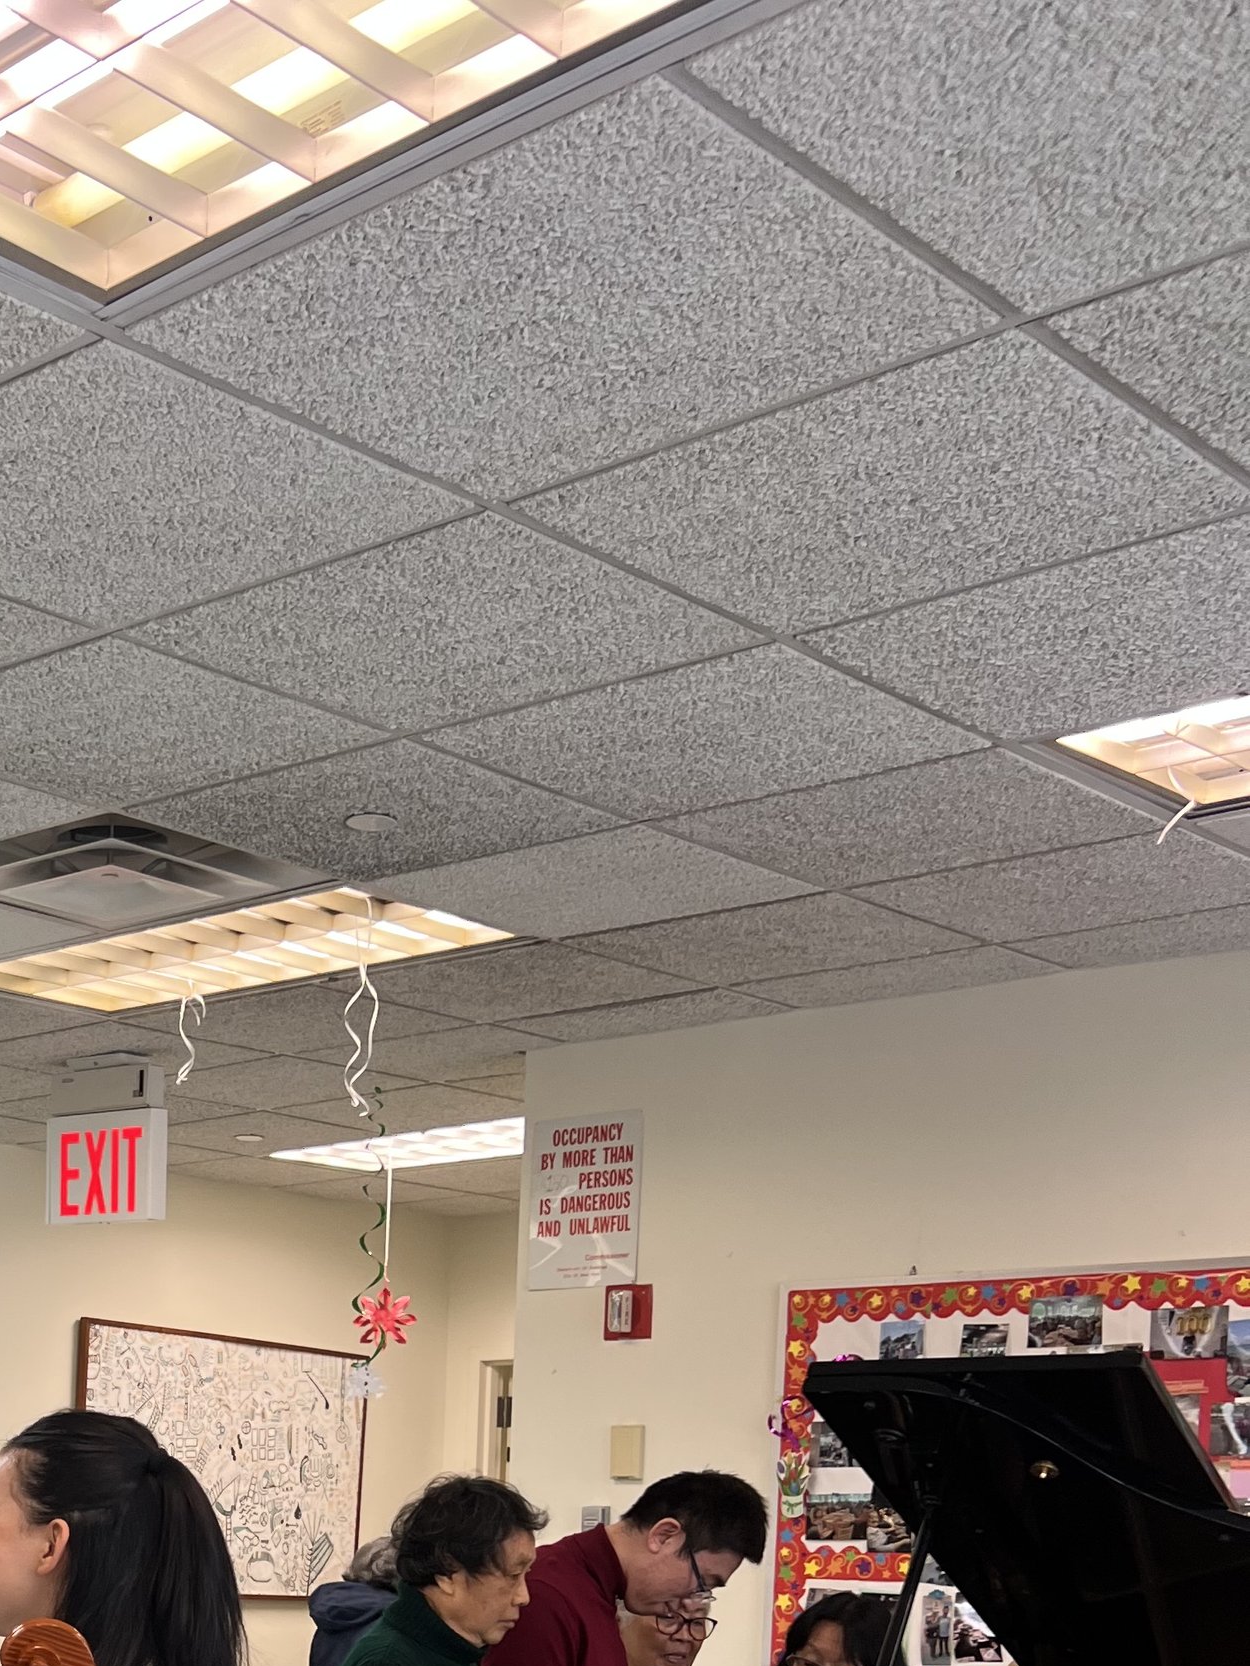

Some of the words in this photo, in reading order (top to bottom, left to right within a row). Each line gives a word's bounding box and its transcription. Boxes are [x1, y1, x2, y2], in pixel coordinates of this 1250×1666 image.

[552, 1122, 624, 1147] OCCUPANCY
[541, 1152, 556, 1171] BY
[562, 1149, 596, 1168] MORE
[603, 1144, 634, 1165] THAN
[59, 1126, 143, 1217] EXIT
[578, 1168, 634, 1190] PERSONS
[539, 1198, 551, 1216] IS
[560, 1191, 631, 1214] DANGEROUS
[537, 1220, 561, 1238] AND
[569, 1214, 631, 1236] UNLAWFUL
